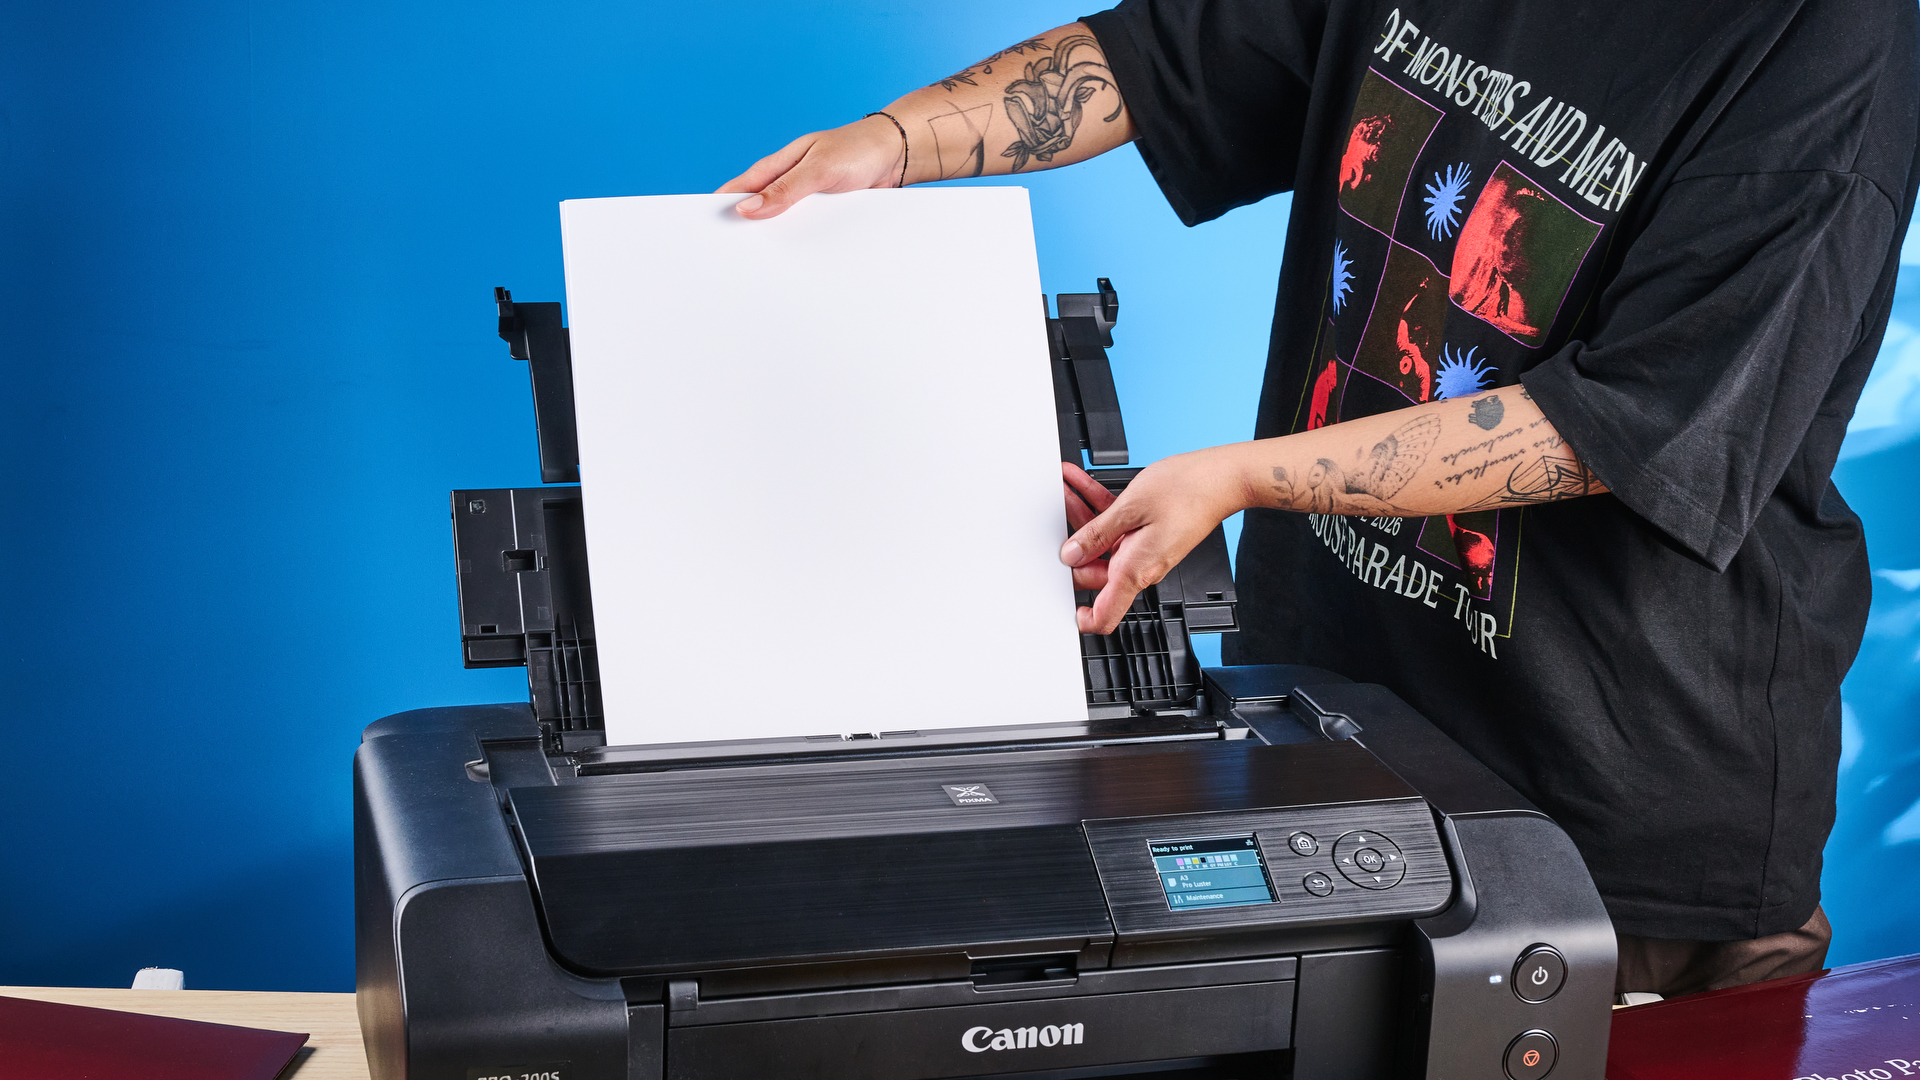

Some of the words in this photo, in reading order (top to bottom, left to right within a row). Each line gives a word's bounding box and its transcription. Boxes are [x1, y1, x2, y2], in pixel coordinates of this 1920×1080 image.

[1403, 36, 1532, 131] MONSTERS
[1500, 95, 1588, 168] AND
[1558, 124, 1648, 213] MEN
[1441, 427, 1524, 466] avalanche
[1179, 844, 1194, 852] print
[1363, 855, 1377, 863] OK
[1186, 893, 1224, 901] Maintenance
[961, 1022, 1084, 1053] Canon
